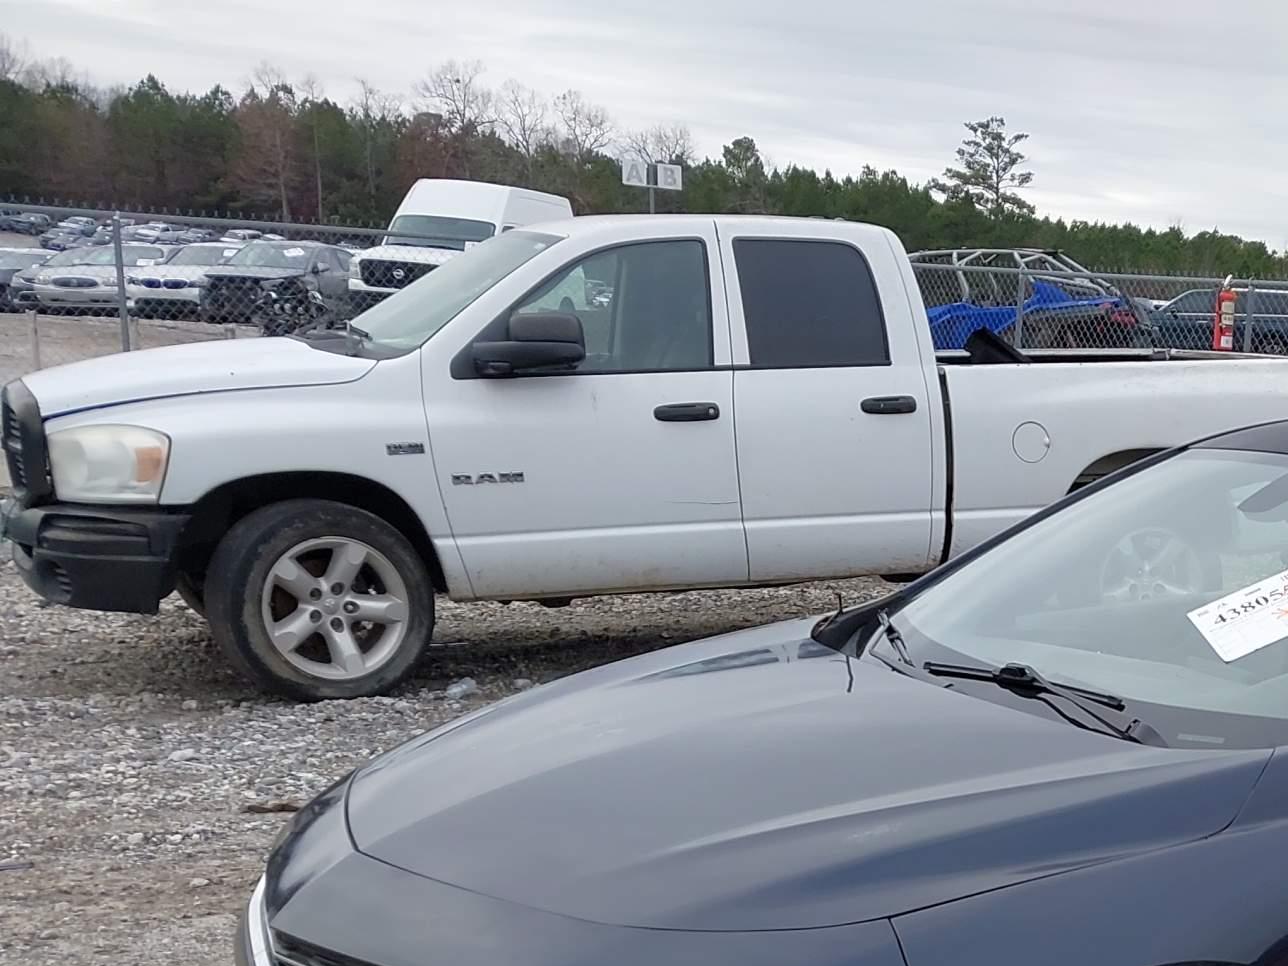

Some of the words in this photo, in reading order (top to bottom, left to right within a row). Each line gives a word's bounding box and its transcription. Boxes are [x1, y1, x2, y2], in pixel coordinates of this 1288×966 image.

[626, 163, 645, 184] A
[663, 166, 677, 187] B
[451, 471, 525, 486] RAM
